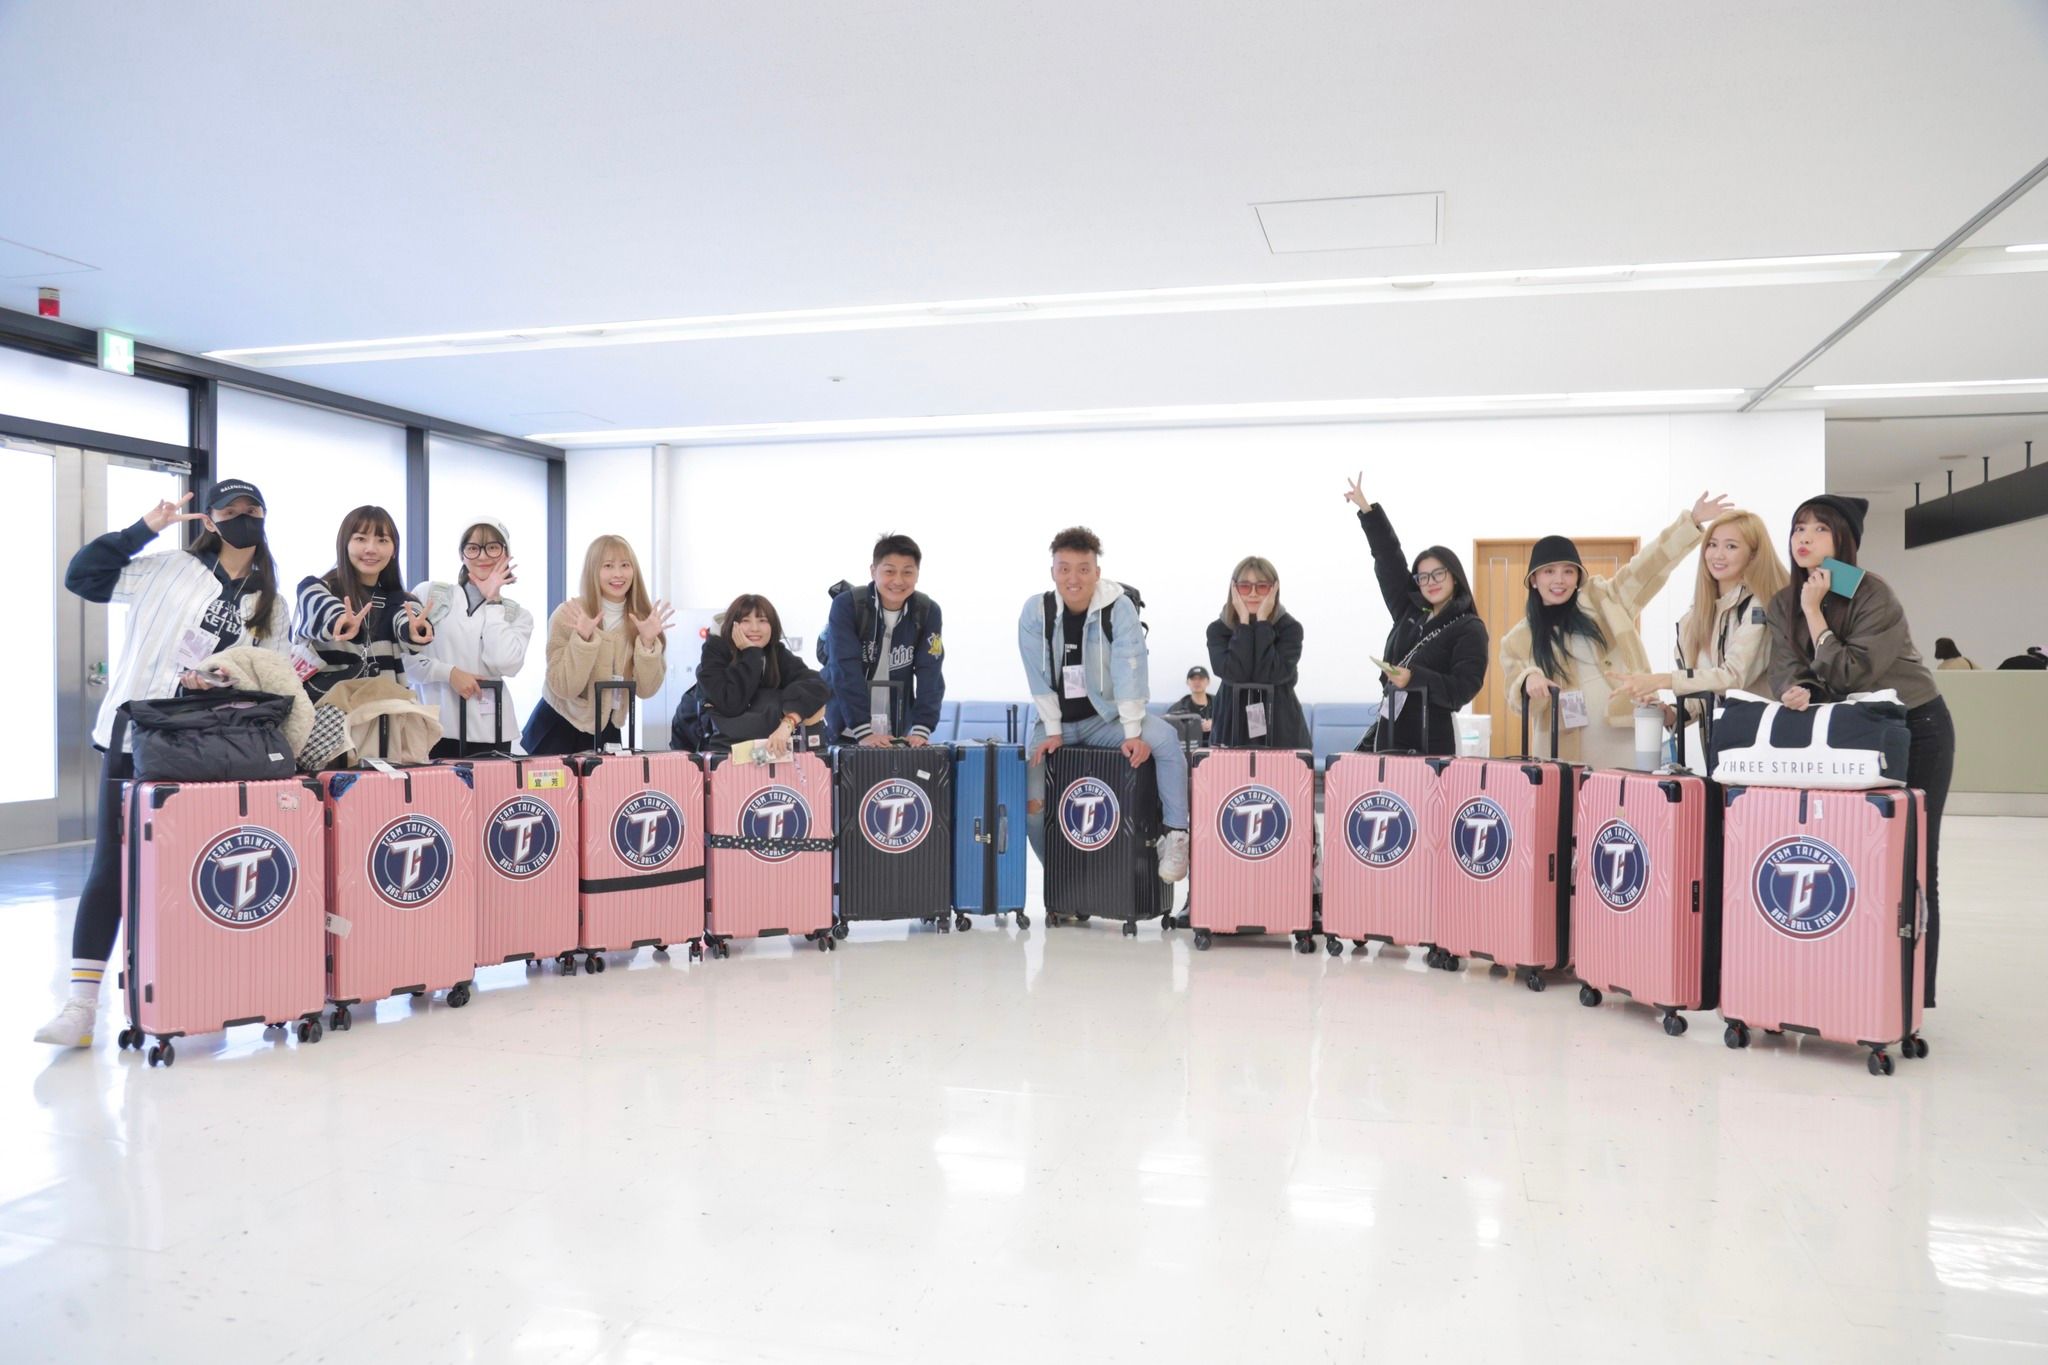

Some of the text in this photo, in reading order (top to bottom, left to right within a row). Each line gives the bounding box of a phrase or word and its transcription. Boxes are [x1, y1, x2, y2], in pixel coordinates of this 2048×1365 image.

[1772, 761, 1824, 774] STRIPE
[1832, 762, 1865, 775] LIFE
[382, 827, 403, 846] TEAM
[874, 831, 902, 846] BASBALL
[1071, 829, 1095, 843] BASBALL
[207, 840, 233, 862] TEAM
[1232, 840, 1262, 854] BASBALL
[1356, 845, 1385, 862] BASBALL
[499, 858, 530, 872] BASBALL
[626, 850, 656, 864] BASBALL
[1461, 854, 1485, 872] BASBALL
[1767, 848, 1792, 867] TEAM
[385, 878, 440, 900] BASBALL TEAM
[1601, 883, 1624, 904] BASBALL
[216, 894, 282, 921] BASBALL TEAM
[1770, 907, 1836, 931] BASBALL TEAM
